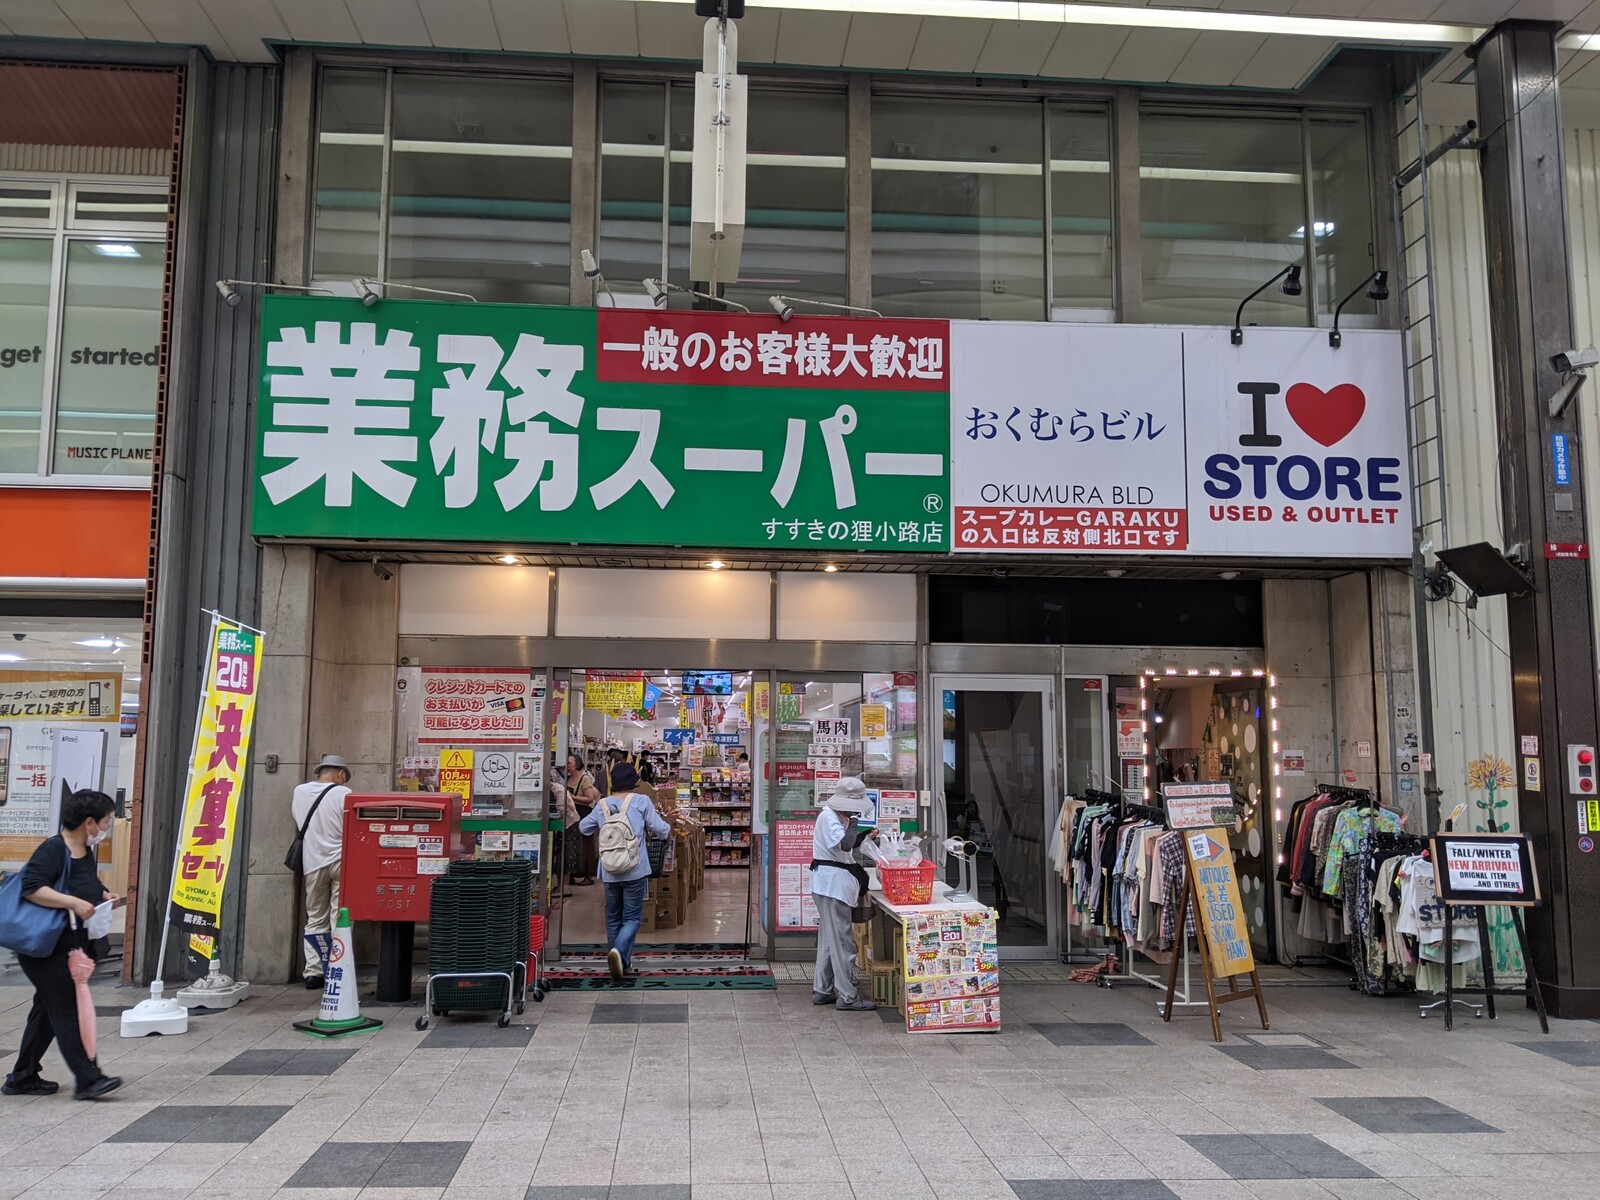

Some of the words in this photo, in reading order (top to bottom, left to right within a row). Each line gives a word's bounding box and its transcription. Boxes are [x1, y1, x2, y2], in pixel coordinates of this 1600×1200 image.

[0, 346, 42, 368] get
[70, 345, 160, 366] started
[603, 326, 944, 379] 一般のお客様大歓迎
[260, 321, 944, 512] 業務スーパー
[1237, 382, 1282, 447] I
[965, 406, 1167, 443] おくむらビル
[67, 447, 108, 459] MUSIC
[1203, 453, 1402, 501] STORE
[981, 483, 1104, 504] OKUMURA
[1112, 486, 1154, 505] BLD
[961, 509, 1179, 527] スープカレーGARAKU
[1209, 505, 1273, 522] USED
[1282, 506, 1298, 522] &
[1307, 507, 1399, 524] OUTLET
[762, 518, 943, 543] すすきの狸小路店
[961, 528, 1179, 545] の入口は反対側北口です
[39, 688, 85, 699] ご利用の方
[424, 679, 525, 695] クレジットカードでの
[424, 697, 485, 711] お支払いが
[423, 715, 524, 730] 可能になりました!!
[816, 720, 849, 736] 馬肉
[664, 731, 694, 739] アイス
[16, 773, 46, 787] 一括
[440, 771, 470, 780] 10月より
[1452, 848, 1512, 859] FALL/WINTER
[1449, 860, 1469, 871] NEW
[1472, 860, 1519, 872] ARRIVAL!!
[185, 886, 209, 896] GYOMU
[1494, 881, 1520, 889] OTHERS
[1207, 903, 1235, 922] USED
